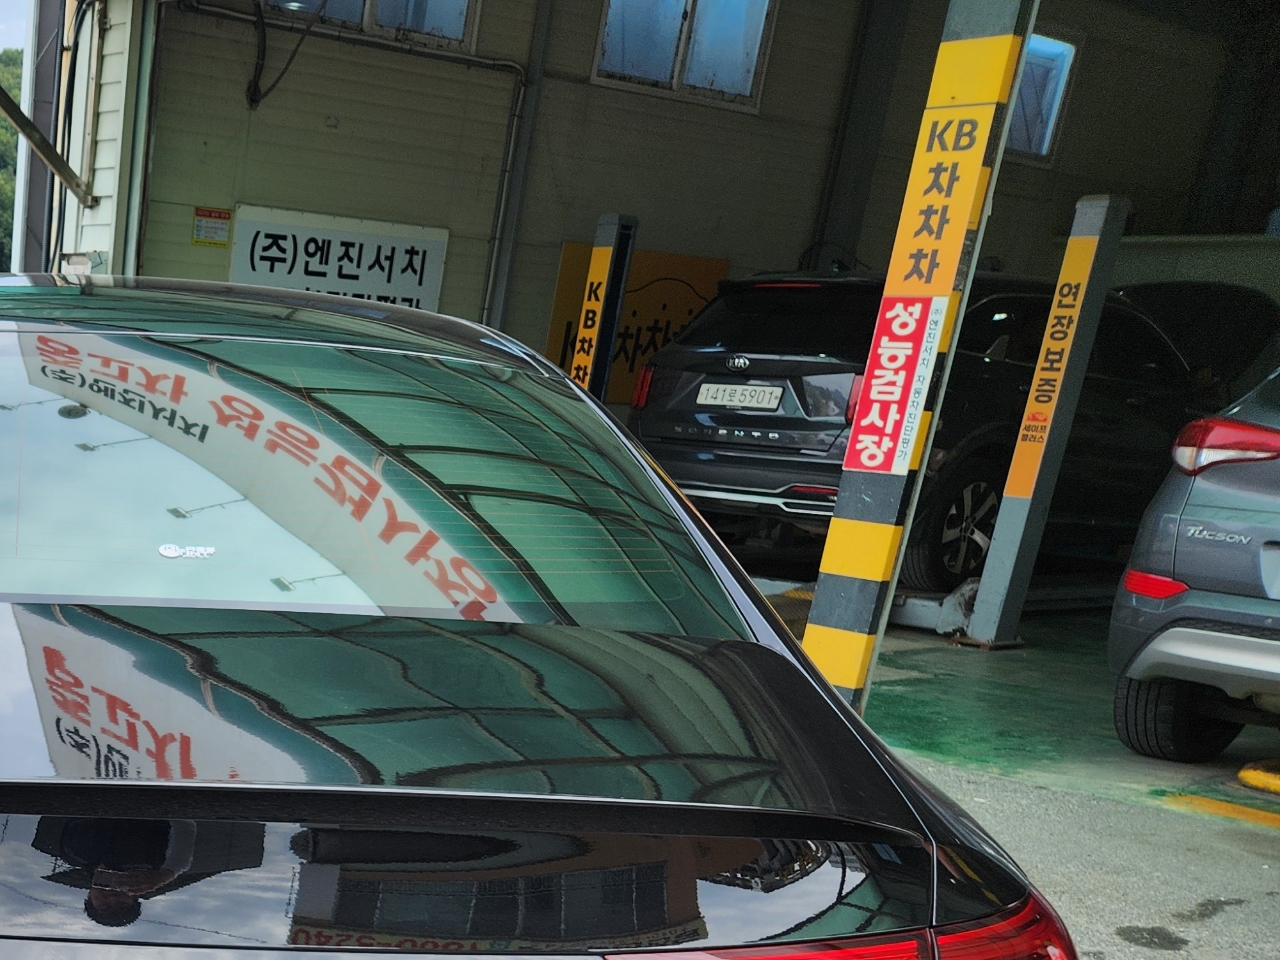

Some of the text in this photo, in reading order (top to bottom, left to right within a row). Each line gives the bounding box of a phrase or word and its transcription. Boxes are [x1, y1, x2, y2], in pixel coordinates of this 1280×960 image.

[249, 229, 427, 287] (주)엔진서치
[855, 302, 923, 468] 성능검사장
[1187, 525, 1252, 545] TUCSON
